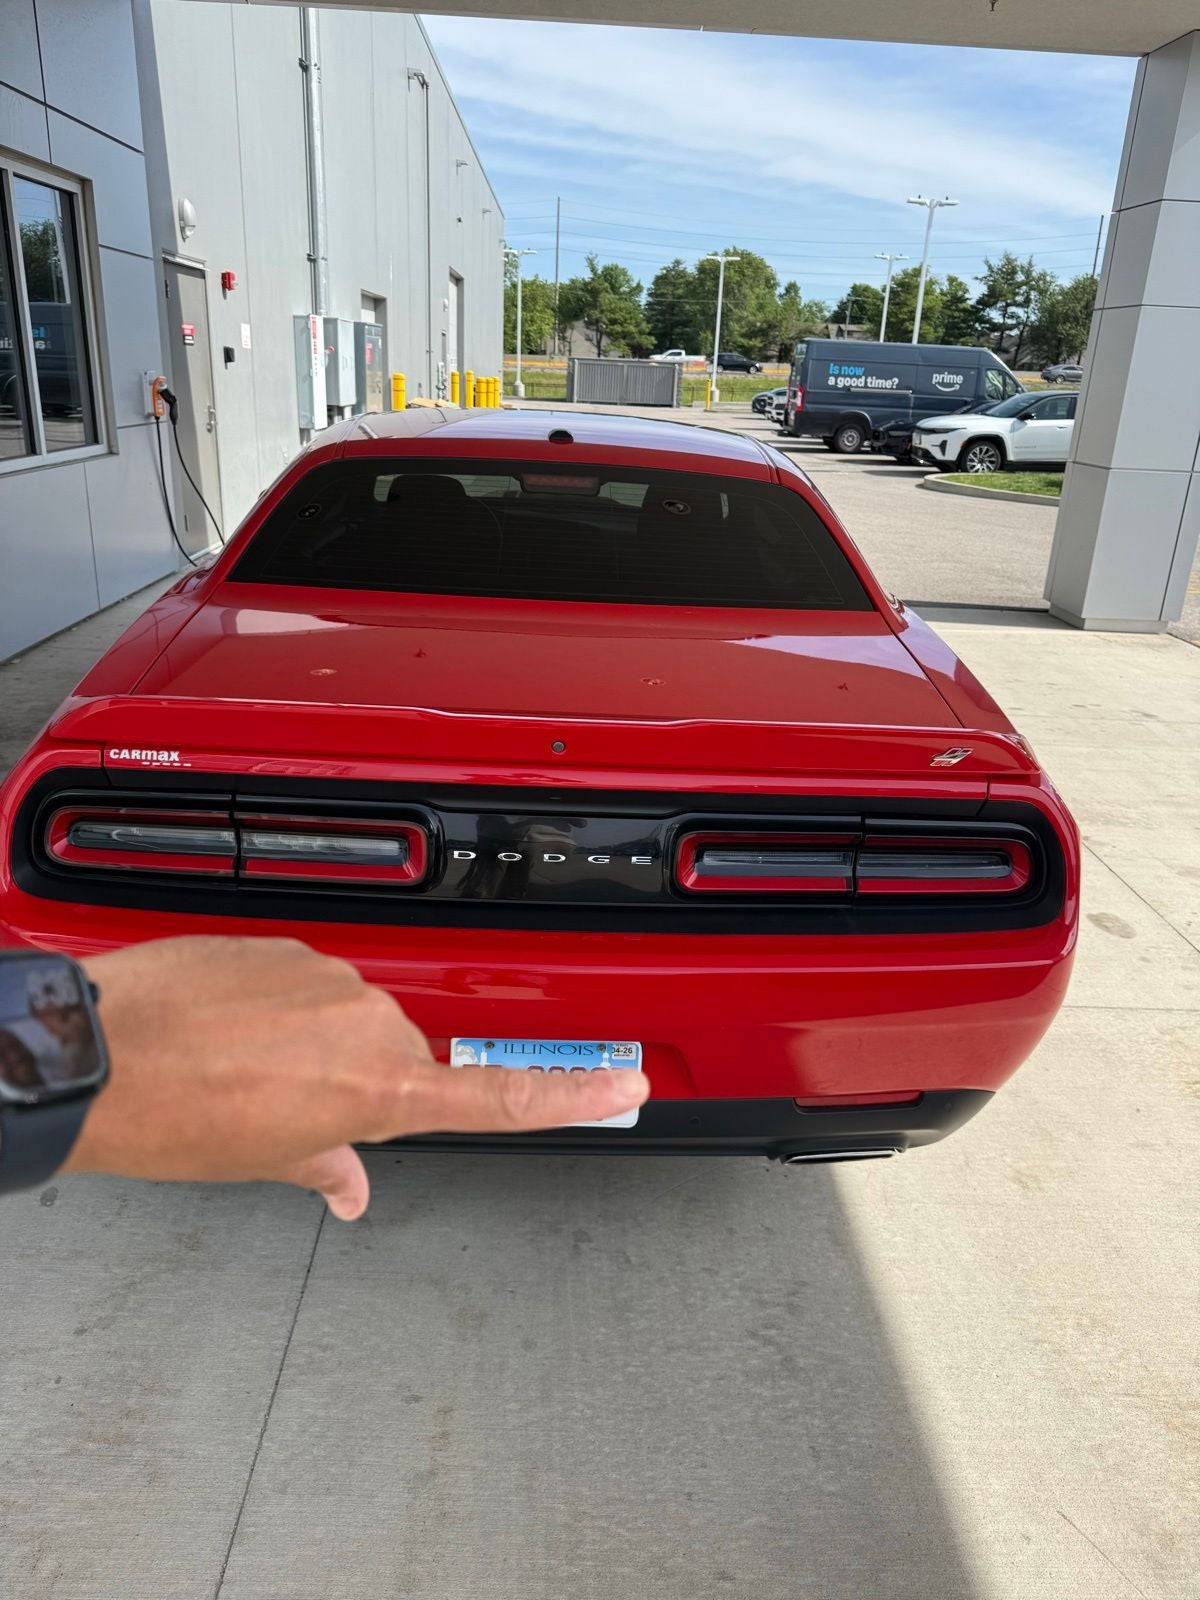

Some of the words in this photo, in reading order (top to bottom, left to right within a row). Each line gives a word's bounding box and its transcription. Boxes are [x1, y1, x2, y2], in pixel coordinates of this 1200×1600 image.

[829, 362, 839, 375] Is
[841, 366, 865, 376] now
[828, 376, 836, 386] a
[837, 376, 866, 388] good
[866, 376, 899, 389] time?
[932, 371, 964, 385] prime
[453, 850, 652, 865] DODGE
[503, 1043, 594, 1057] ILLINOIS
